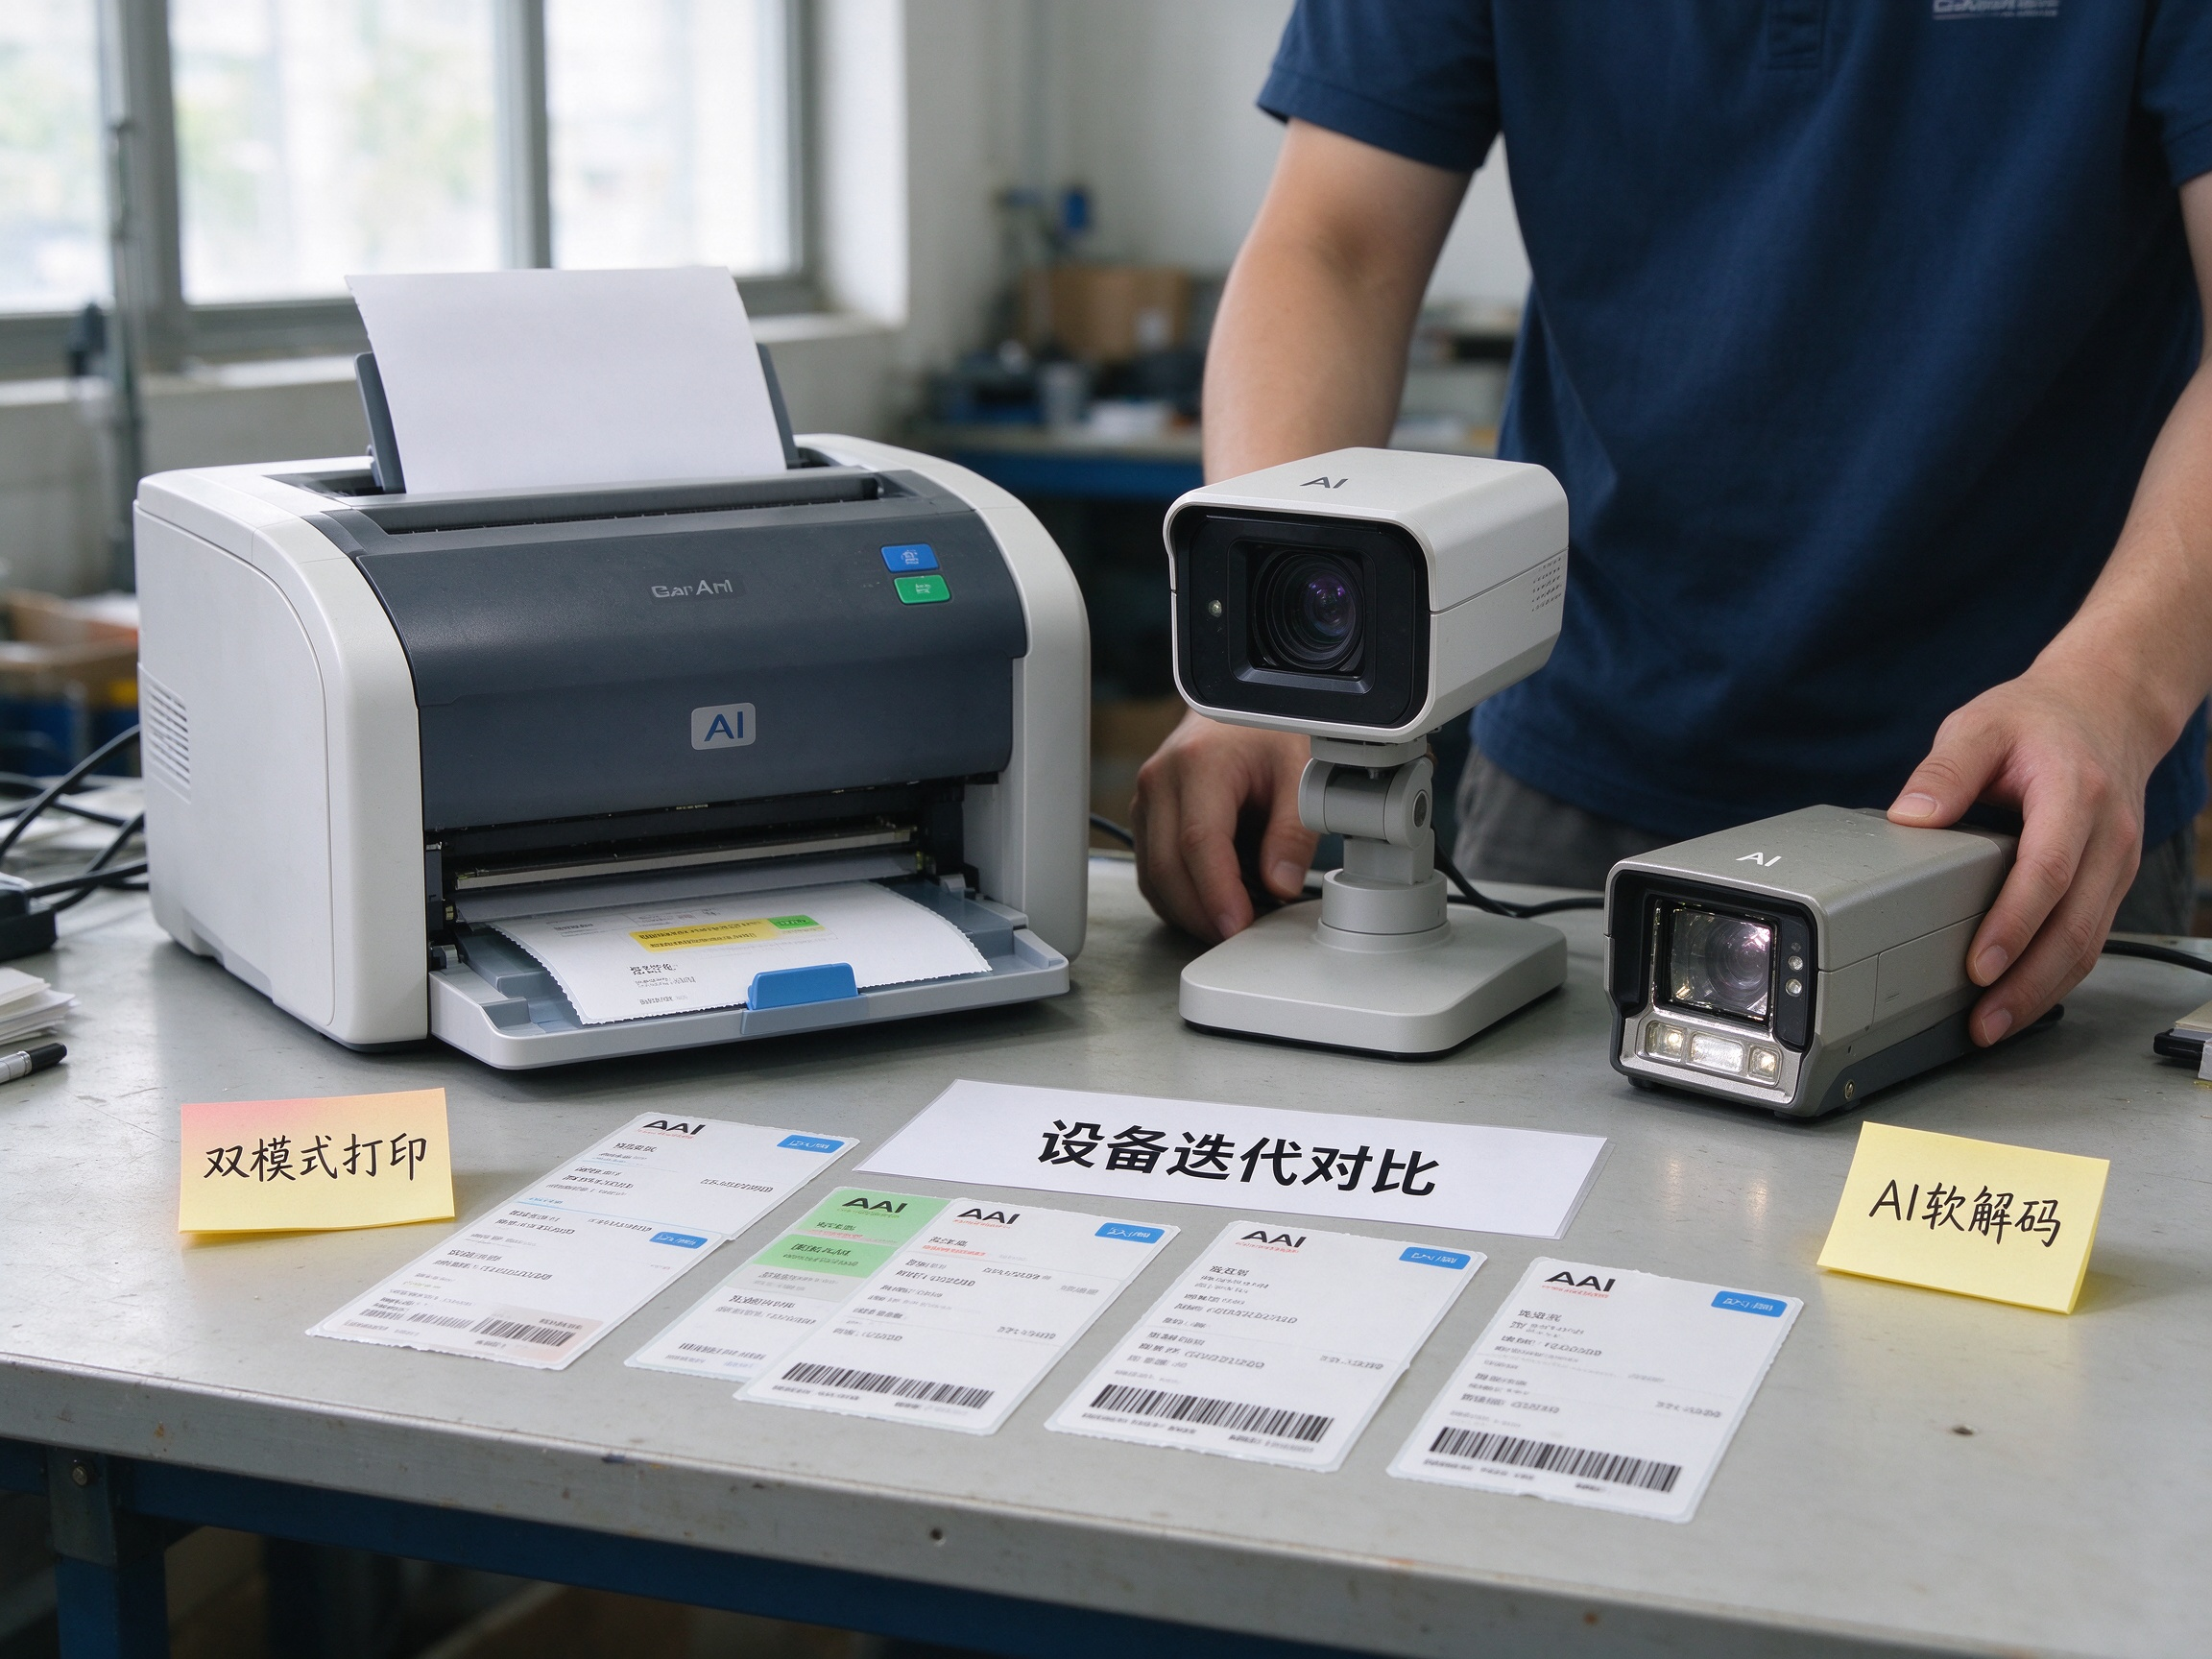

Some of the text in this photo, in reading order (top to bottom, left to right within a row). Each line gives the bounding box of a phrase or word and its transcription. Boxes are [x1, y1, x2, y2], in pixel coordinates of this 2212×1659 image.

[1300, 476, 1349, 490] AI
[704, 710, 744, 742] AI
[1736, 852, 1782, 868] AI
[642, 1119, 707, 1135] AAI
[204, 1131, 427, 1183] 双模式打印
[1037, 1118, 1440, 1197] 设备迭代对比
[841, 1197, 908, 1214] AAI
[1868, 1179, 2061, 1248] AI软解码
[956, 1208, 1020, 1225] AAI
[1239, 1230, 1307, 1248] AAI
[1544, 1271, 1617, 1292] AAI
